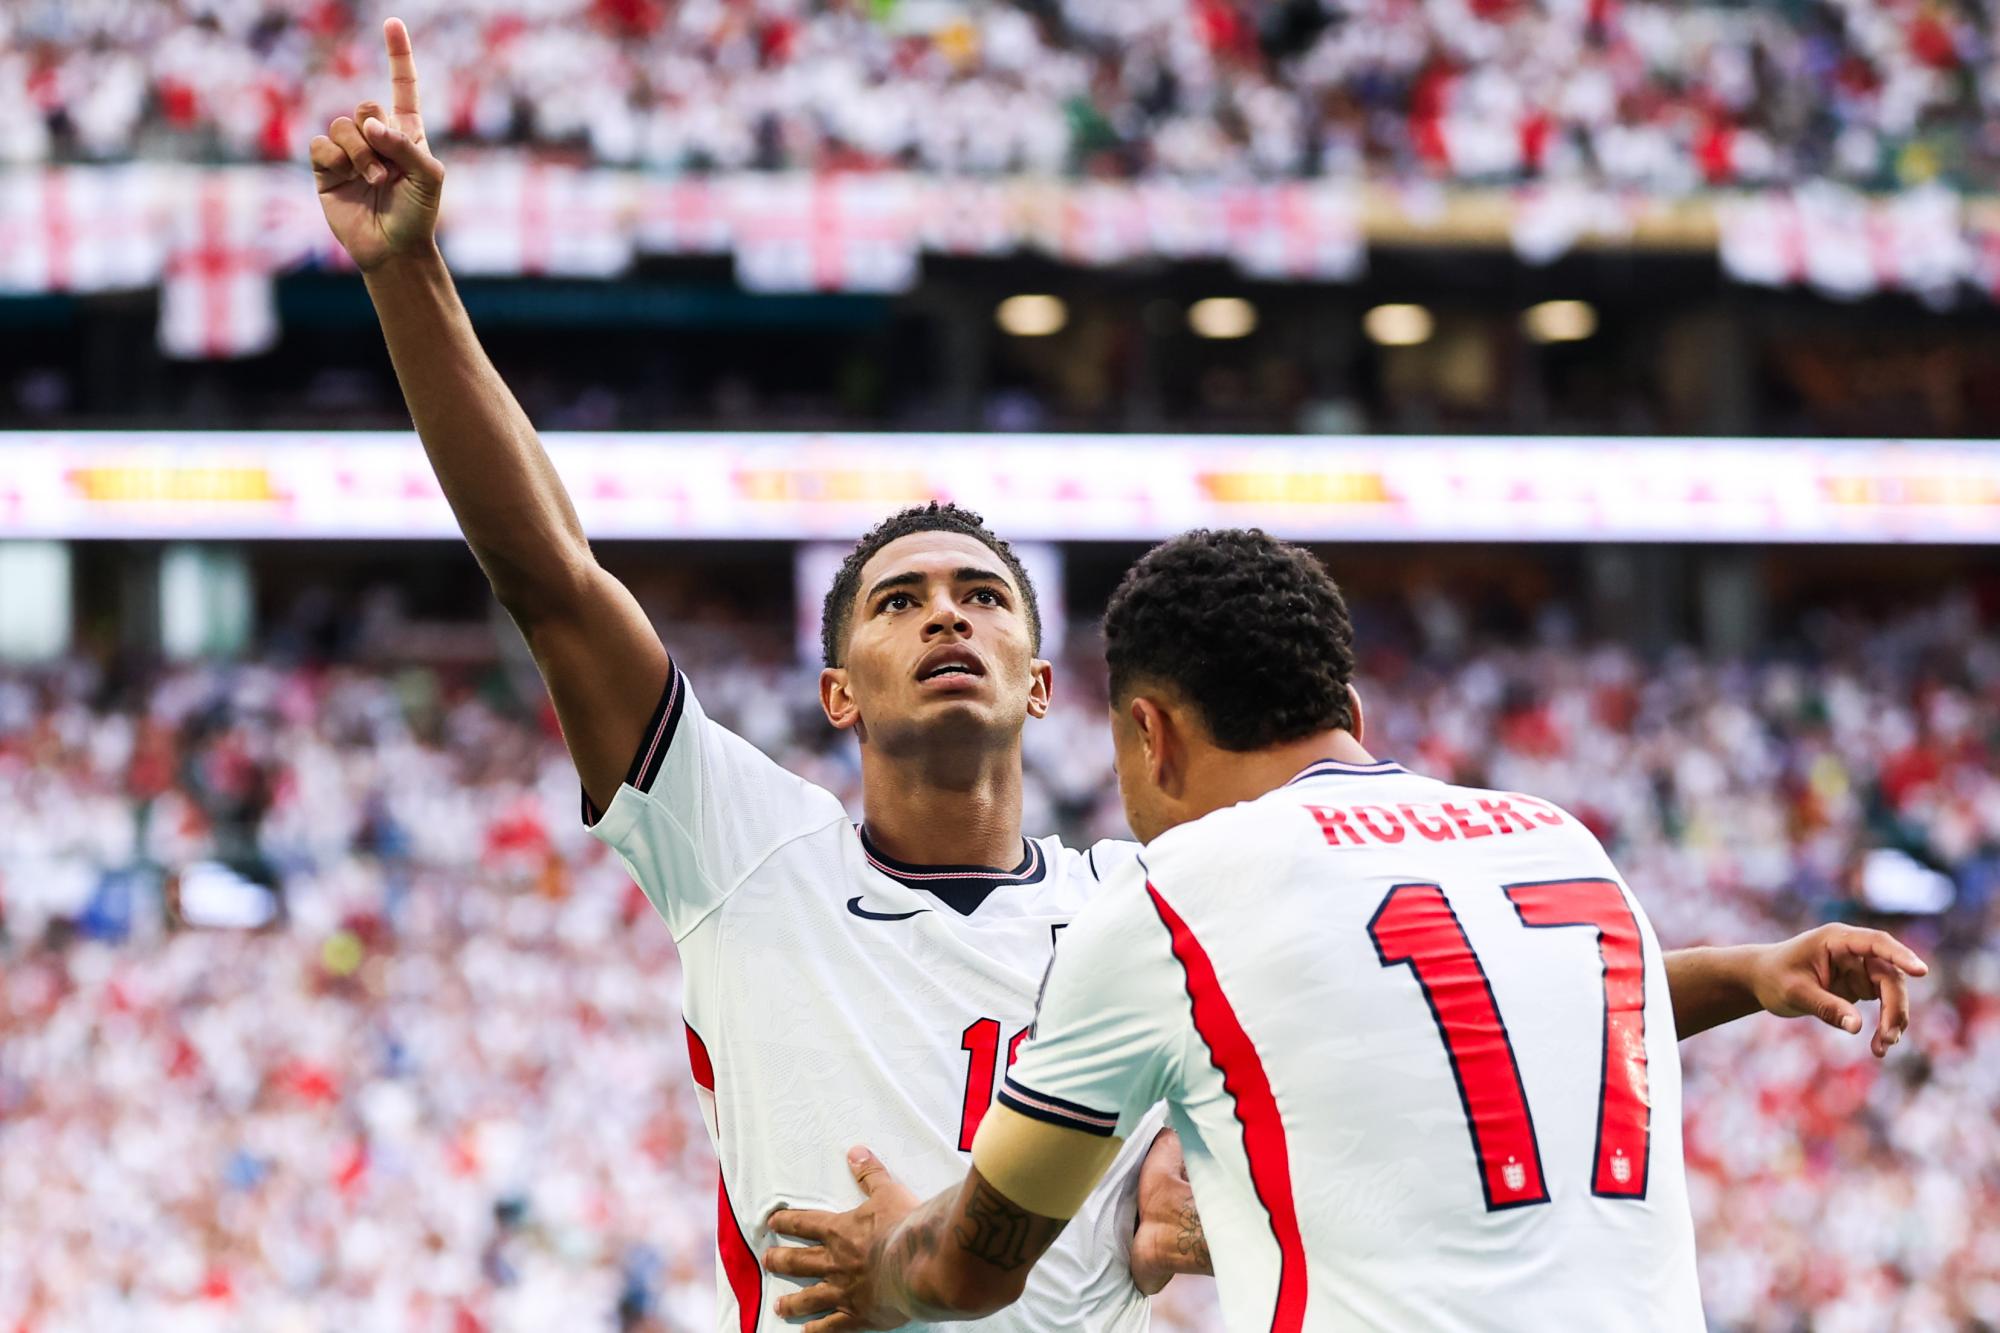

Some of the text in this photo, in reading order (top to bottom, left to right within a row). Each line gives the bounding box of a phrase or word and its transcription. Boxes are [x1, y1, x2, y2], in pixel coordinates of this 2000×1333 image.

[1301, 793, 1564, 845] ROGERS
[958, 1016, 1029, 1153] 1
[1366, 877, 1651, 1212] 17
